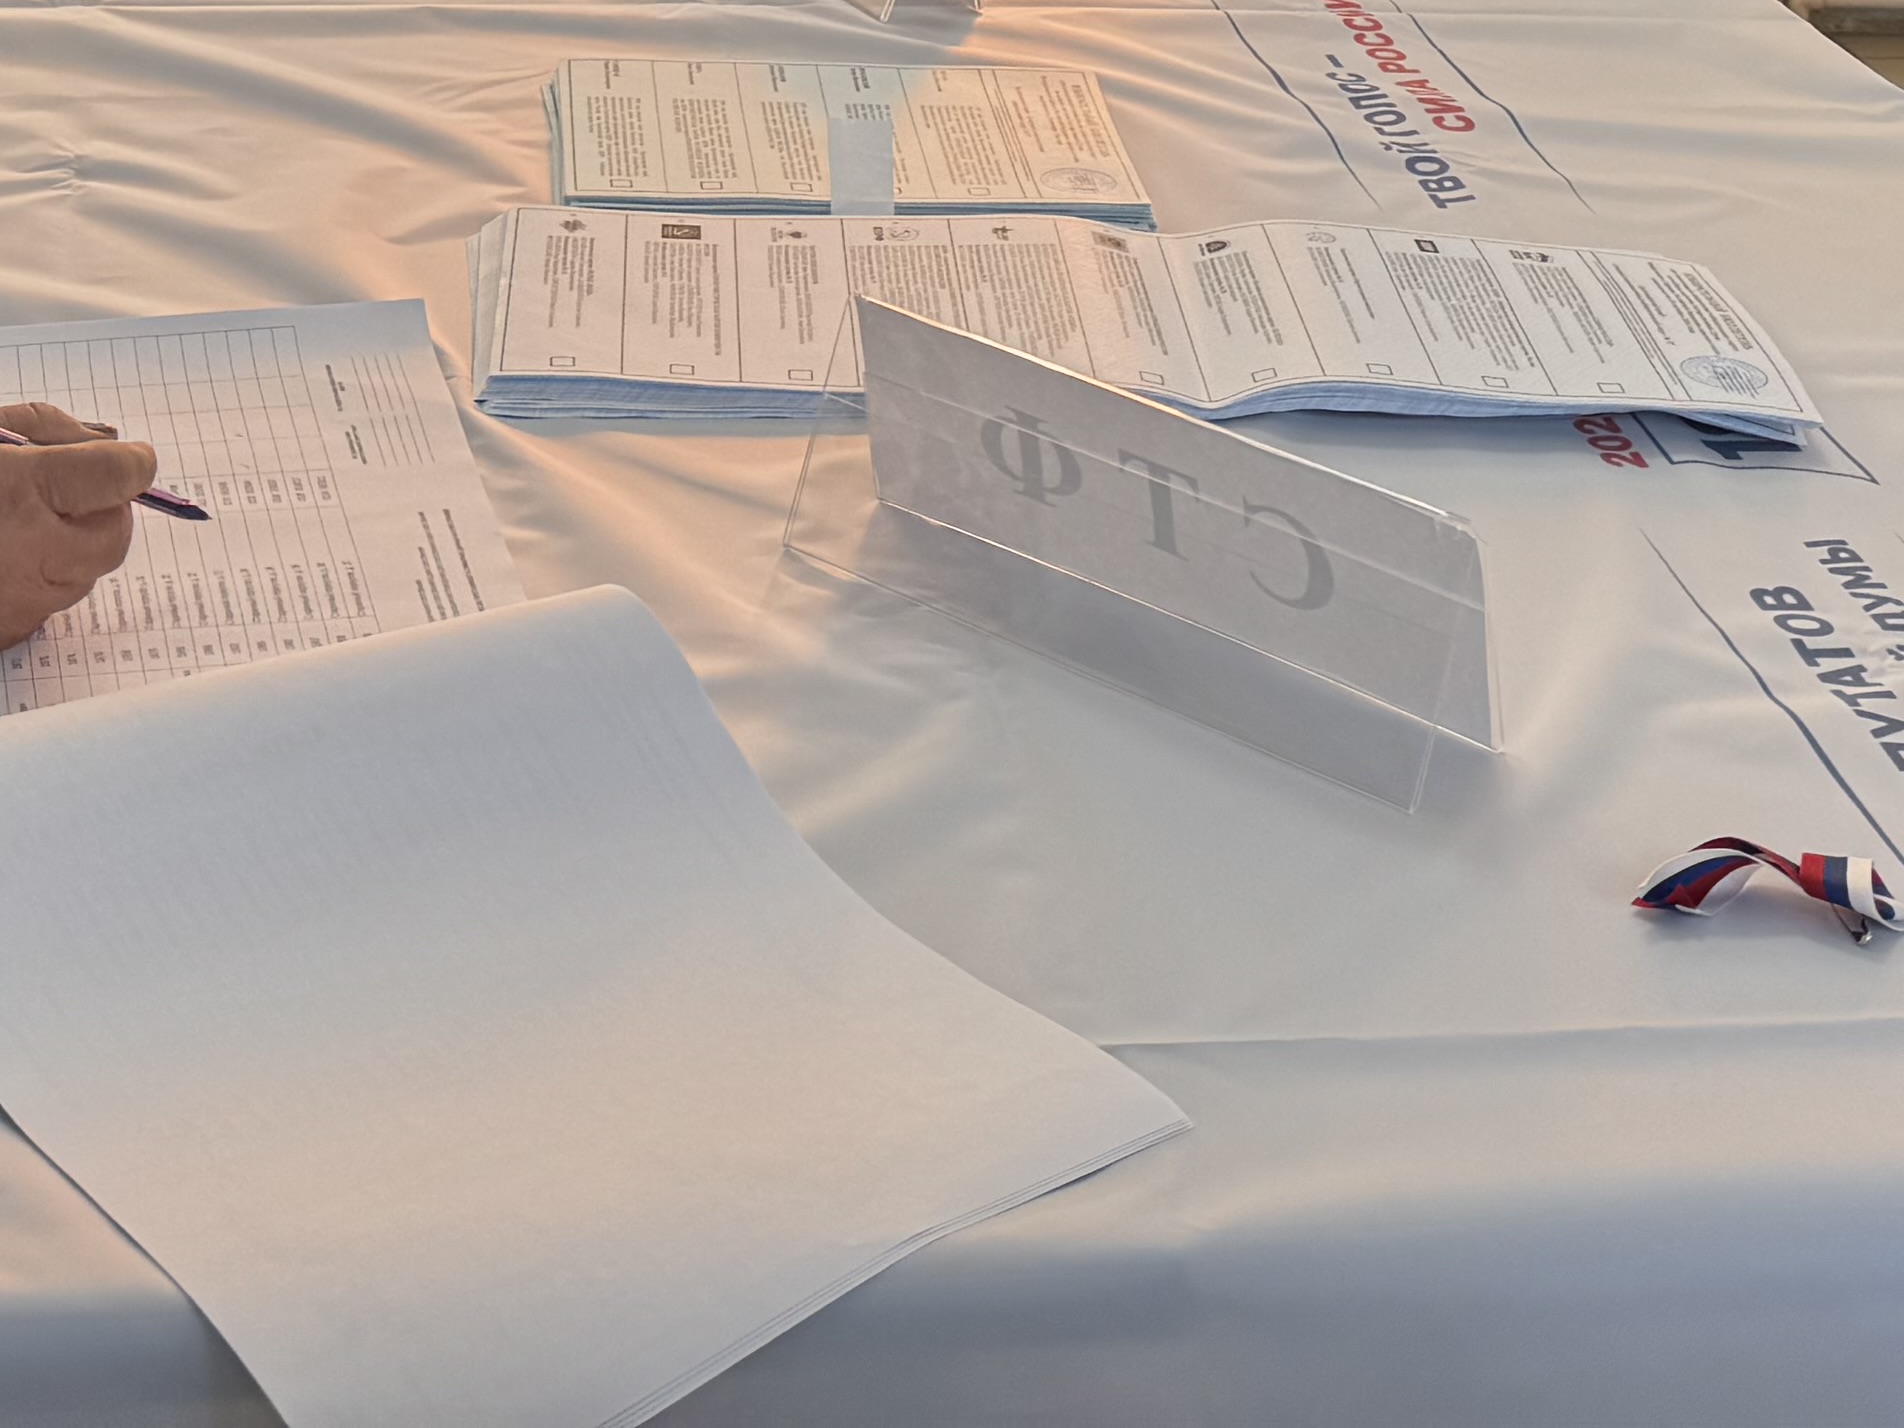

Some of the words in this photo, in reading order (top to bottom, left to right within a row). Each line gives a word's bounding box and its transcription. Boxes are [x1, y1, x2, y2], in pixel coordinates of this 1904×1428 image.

[1324, 71, 1421, 137] ГОЛОС
[1394, 78, 1477, 134] СИЛА
[1378, 139, 1477, 210] ТВОЙ
[1571, 414, 1650, 469] 202
